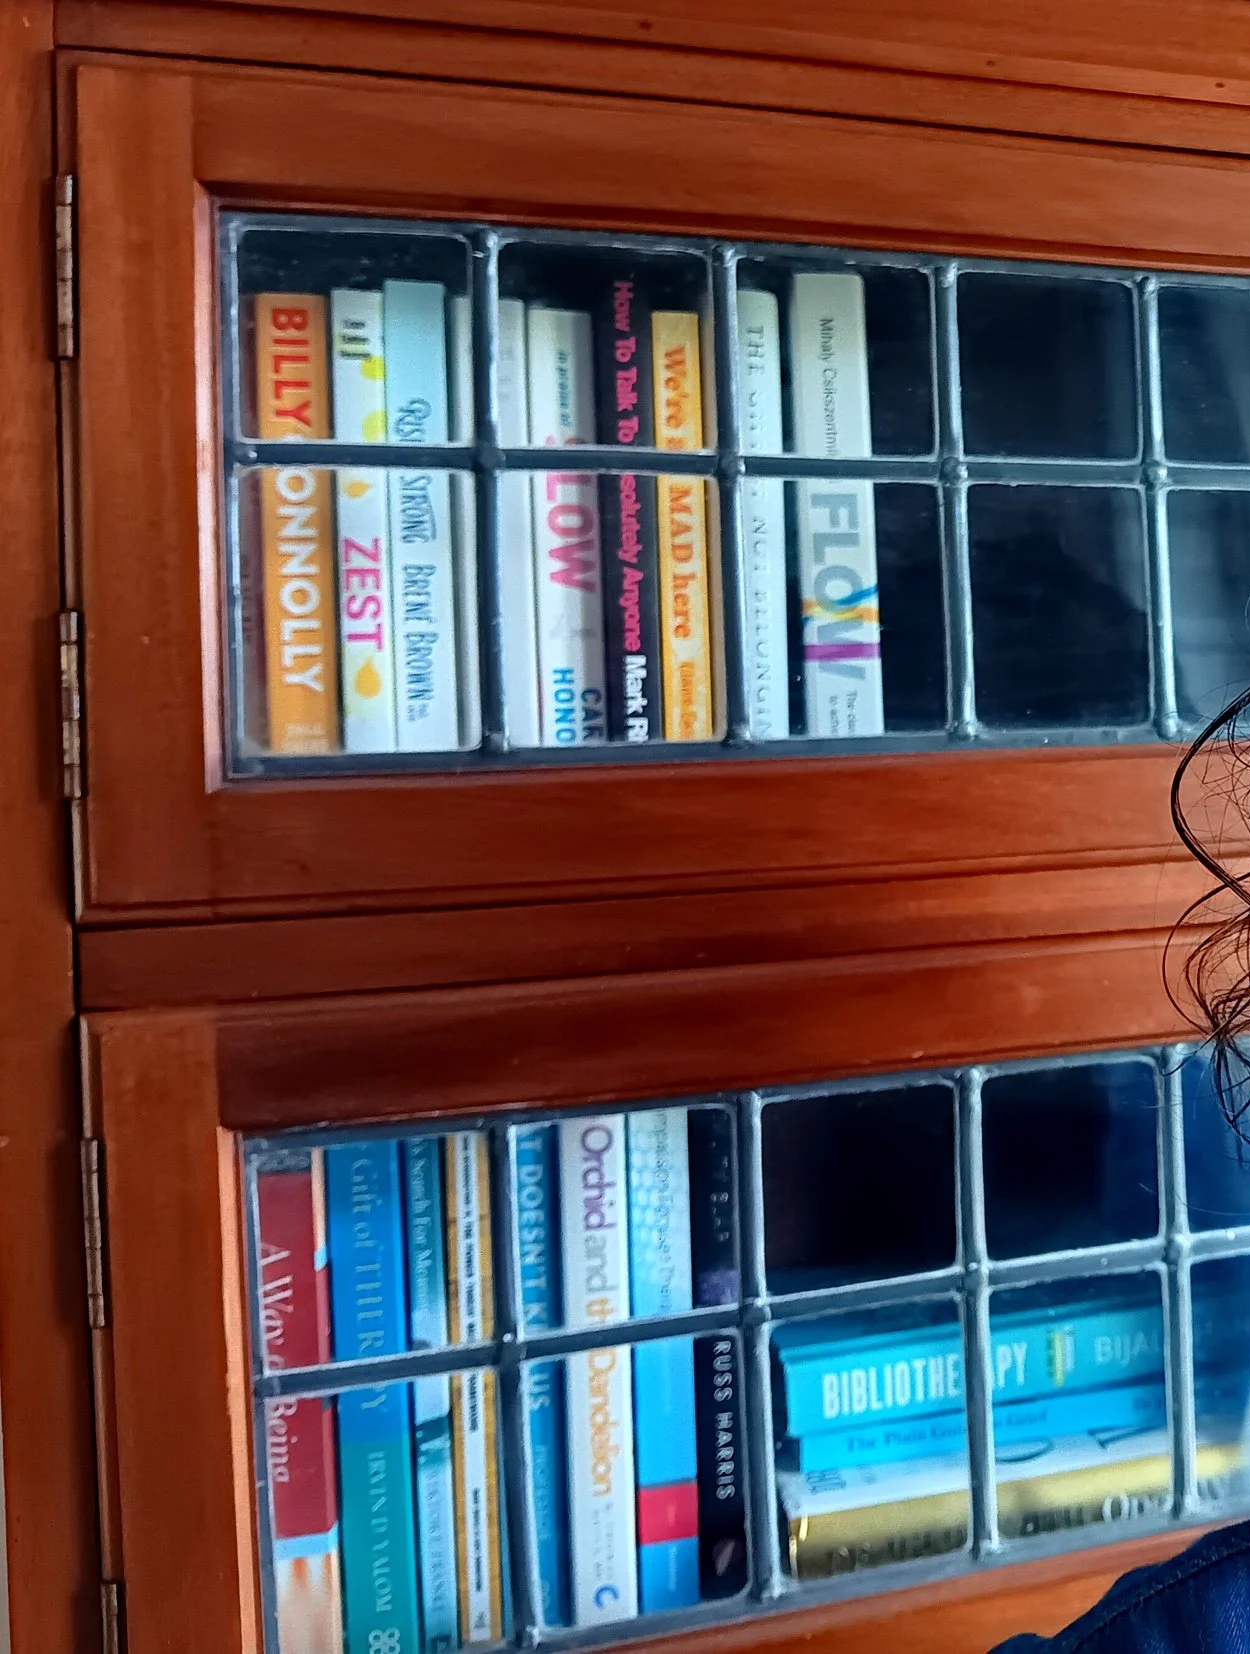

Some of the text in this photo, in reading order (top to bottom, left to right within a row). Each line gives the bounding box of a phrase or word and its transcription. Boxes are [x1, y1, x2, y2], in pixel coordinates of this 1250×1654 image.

[612, 280, 634, 332] How
[819, 317, 835, 362] Mihaly
[272, 307, 312, 428] BILLY
[614, 336, 637, 363] To
[746, 326, 766, 377] THE
[616, 366, 639, 413] Talk
[664, 346, 690, 429] We're
[617, 416, 640, 443] To
[400, 474, 437, 543] STRONG
[618, 472, 644, 565] solutely
[669, 485, 695, 564] MAD
[275, 436, 324, 693] ONNOLLY
[342, 536, 384, 651] ZEST
[810, 493, 867, 680] FLOW
[619, 566, 644, 652] Anyone
[672, 571, 697, 639] here
[403, 631, 439, 701] BROWN
[624, 655, 648, 715] Mark
[553, 667, 577, 745] HONO
[581, 687, 604, 739] CAR
[351, 1159, 383, 1214] Gift
[581, 1126, 618, 1232] Orchid
[259, 1241, 290, 1268] A
[518, 1164, 549, 1290] DOESN'T
[585, 1235, 618, 1294] and
[355, 1254, 388, 1410] THERY
[585, 1297, 616, 1325] th
[528, 1365, 551, 1412] US
[822, 1341, 1028, 1421] BIBLIOTHEPY
[266, 1399, 299, 1484] Being
[587, 1349, 620, 1498] Dandelion
[712, 1339, 736, 1501] RUSS HARRIS
[367, 1451, 387, 1513] IRVIN
[372, 1539, 392, 1613] YALOM
